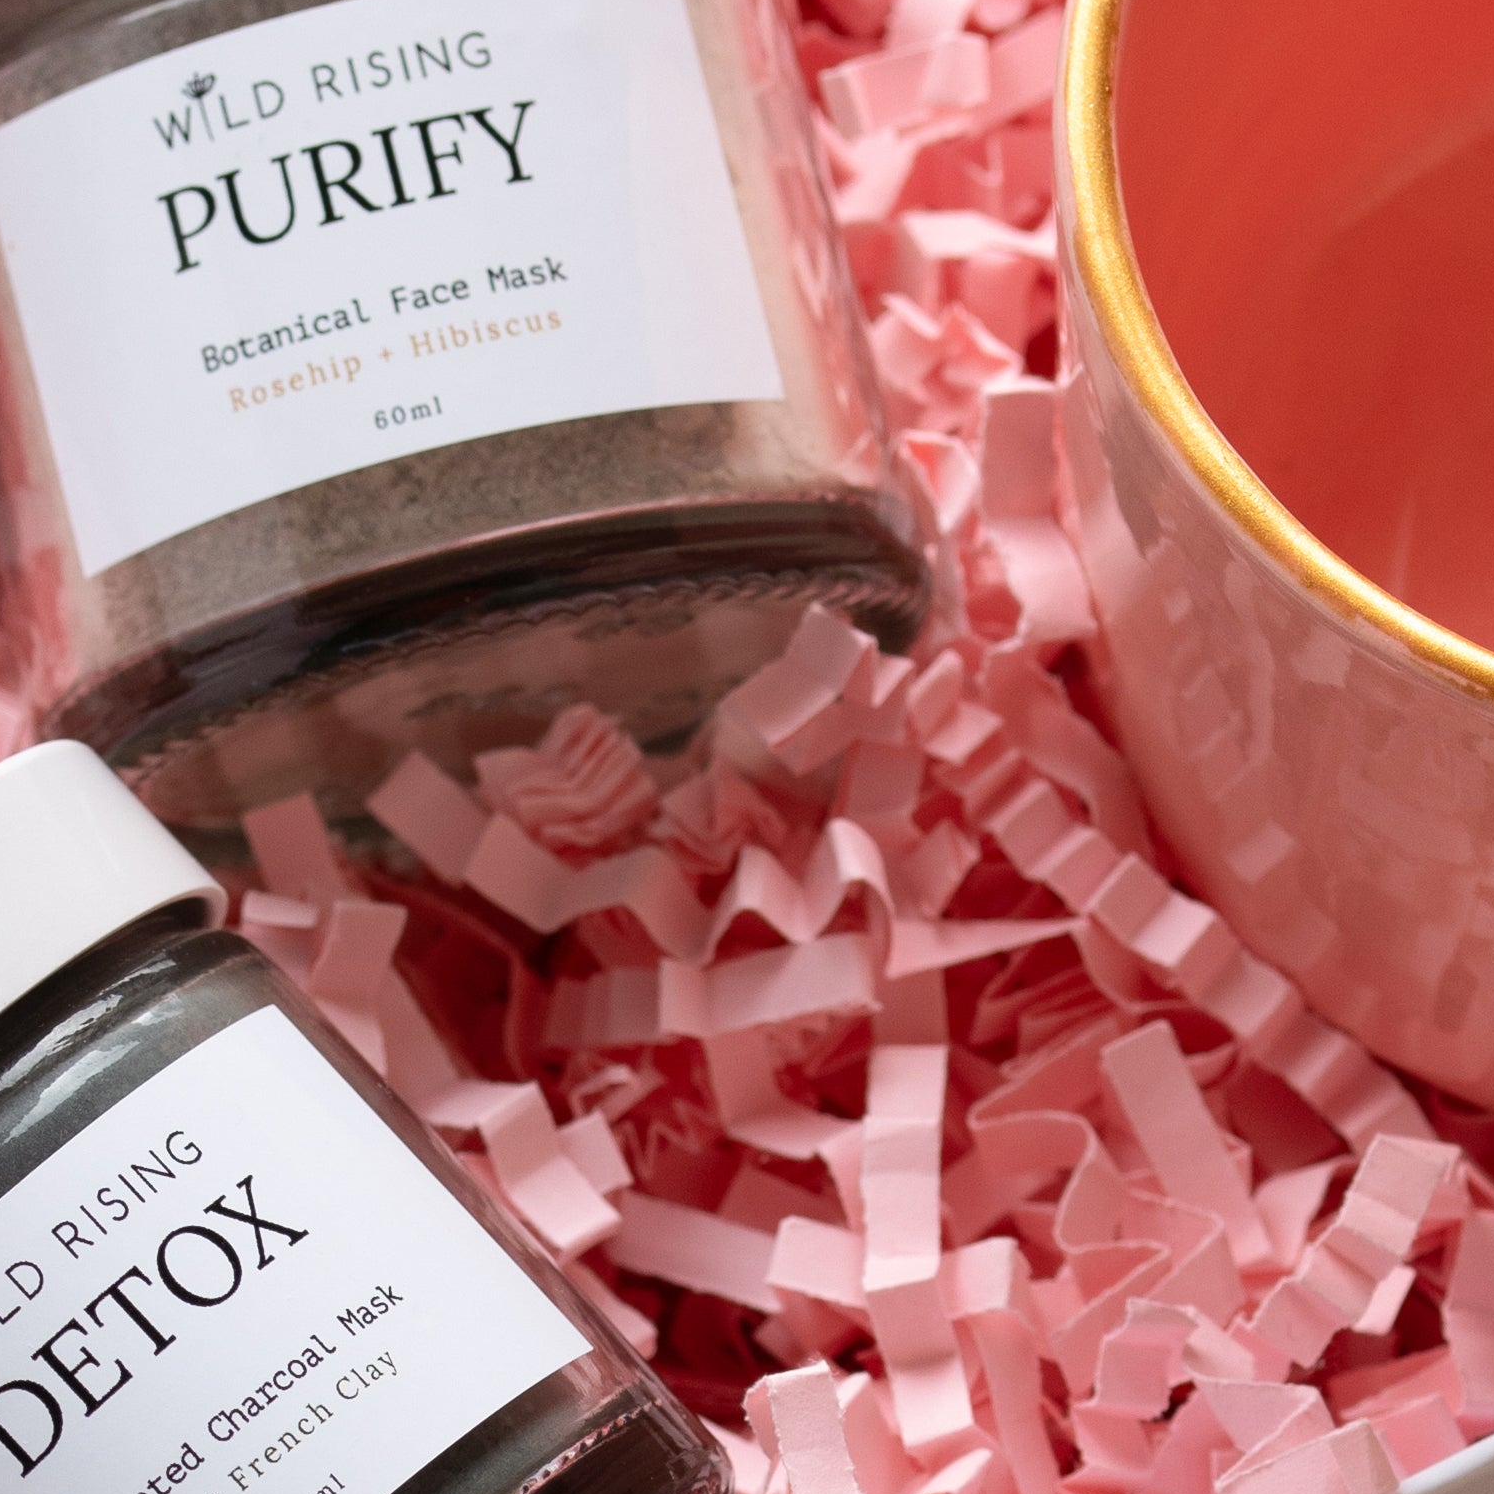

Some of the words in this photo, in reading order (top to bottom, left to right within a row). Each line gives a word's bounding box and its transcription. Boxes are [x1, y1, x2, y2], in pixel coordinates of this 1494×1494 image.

[152, 71, 286, 151] WILD
[310, 30, 493, 104] RISING
[155, 99, 537, 276] PURIFY
[200, 298, 372, 375] Botanical
[389, 278, 471, 316] Face
[484, 255, 569, 294] Mask
[229, 356, 363, 413] Rosehip
[409, 311, 563, 359] Hibiscus
[373, 395, 444, 431] 60ml
[50, 1129, 204, 1260] RISING
[206, 1333, 339, 1443] Charcoal
[335, 1284, 405, 1338] Mask
[226, 1401, 336, 1494] French
[334, 1350, 400, 1402] Clay
